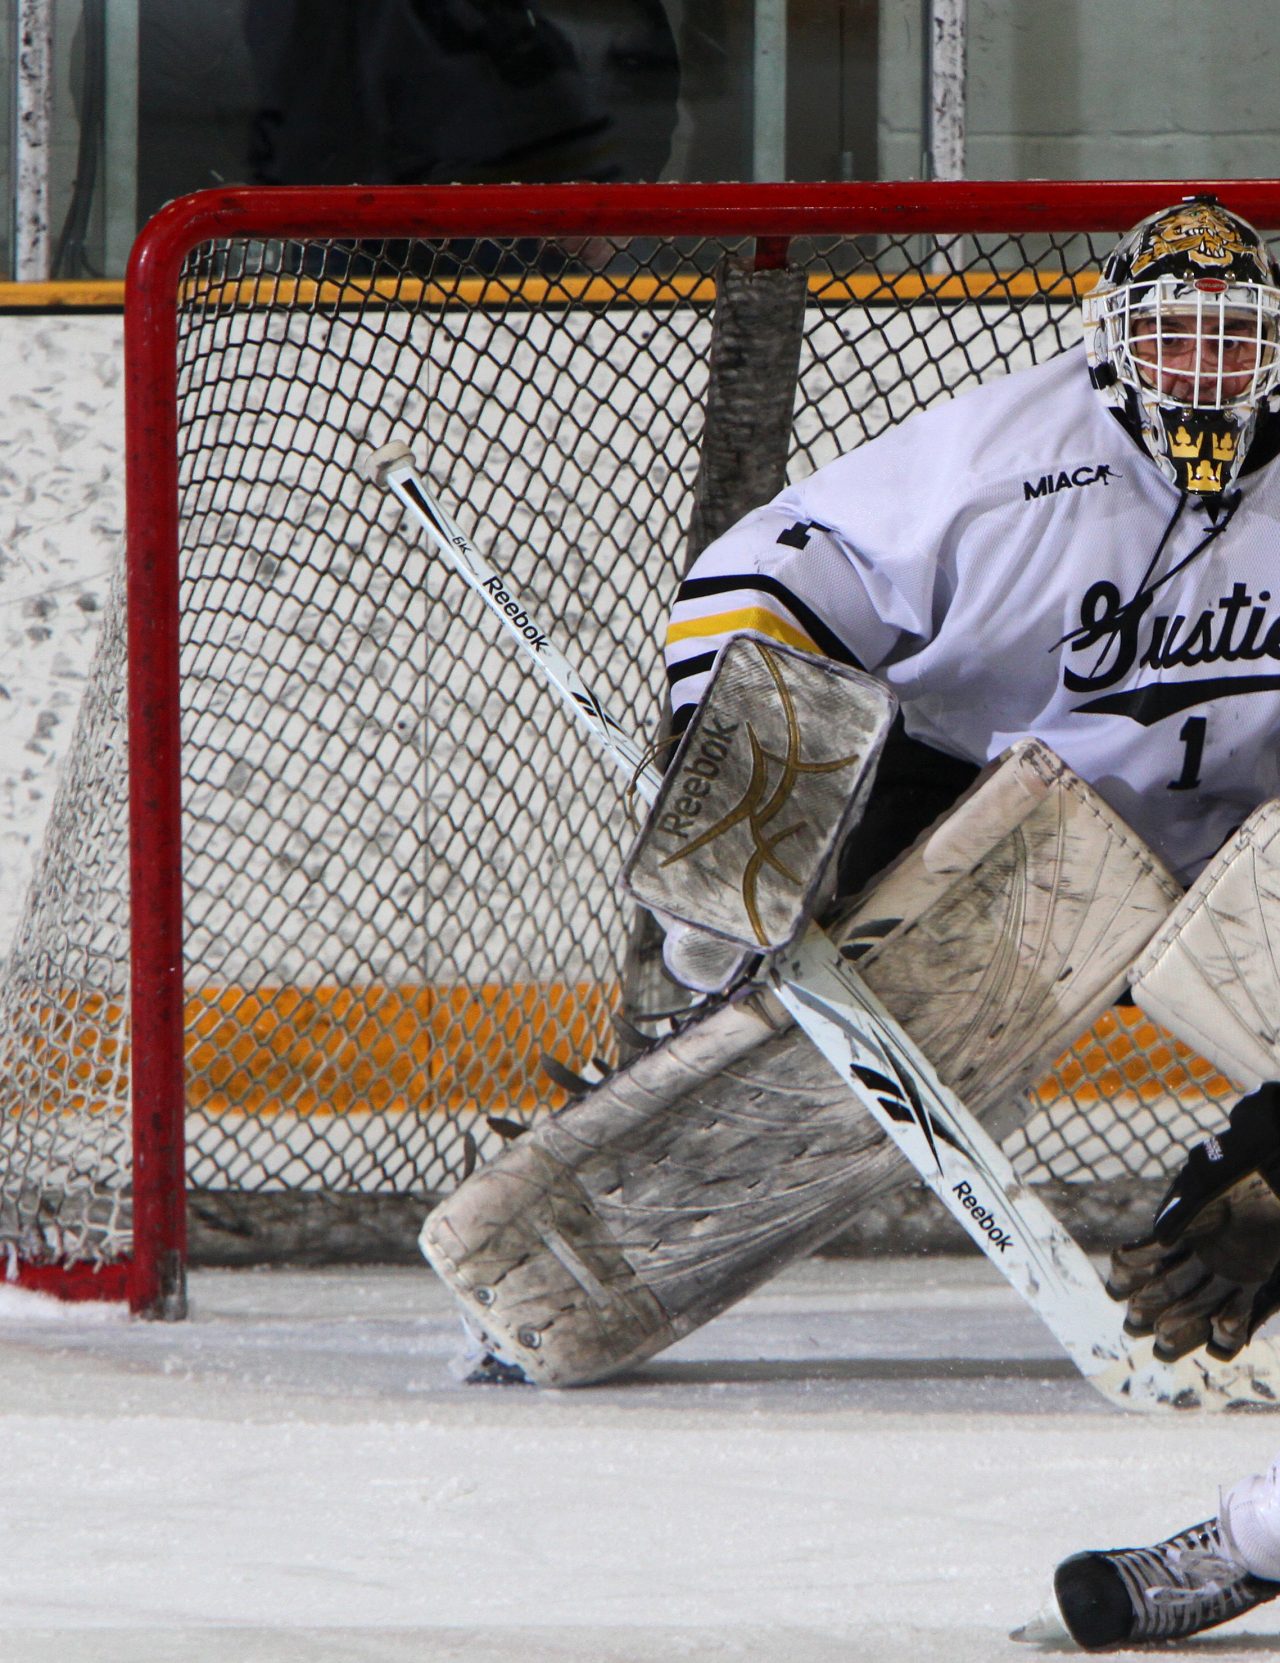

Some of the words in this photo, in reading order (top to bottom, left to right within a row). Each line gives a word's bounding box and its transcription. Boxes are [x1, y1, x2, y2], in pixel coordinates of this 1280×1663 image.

[1023, 466, 1096, 501] MIAC
[482, 575, 549, 653] Reebok
[658, 718, 740, 840] Reebok
[1166, 716, 1208, 791] 1
[952, 1180, 1014, 1253] Reebok
